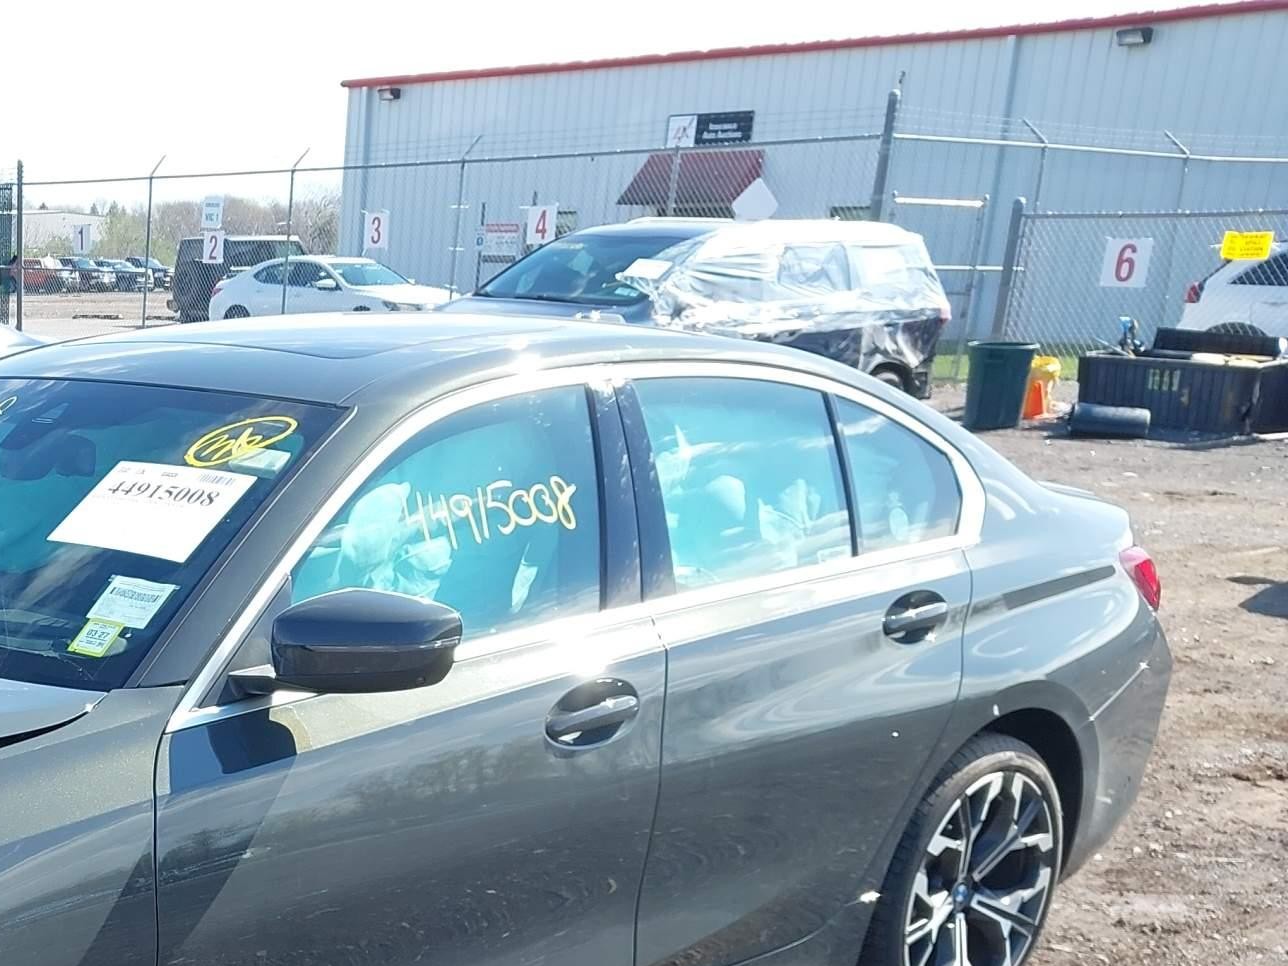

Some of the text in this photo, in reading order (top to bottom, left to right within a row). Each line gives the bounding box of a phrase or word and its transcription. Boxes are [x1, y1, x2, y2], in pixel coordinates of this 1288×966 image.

[370, 216, 381, 244] 3
[535, 209, 547, 240] 4
[209, 235, 217, 260] 2
[1114, 243, 1138, 282] 6
[108, 480, 220, 507] 44915008
[400, 475, 577, 550] 44915008
